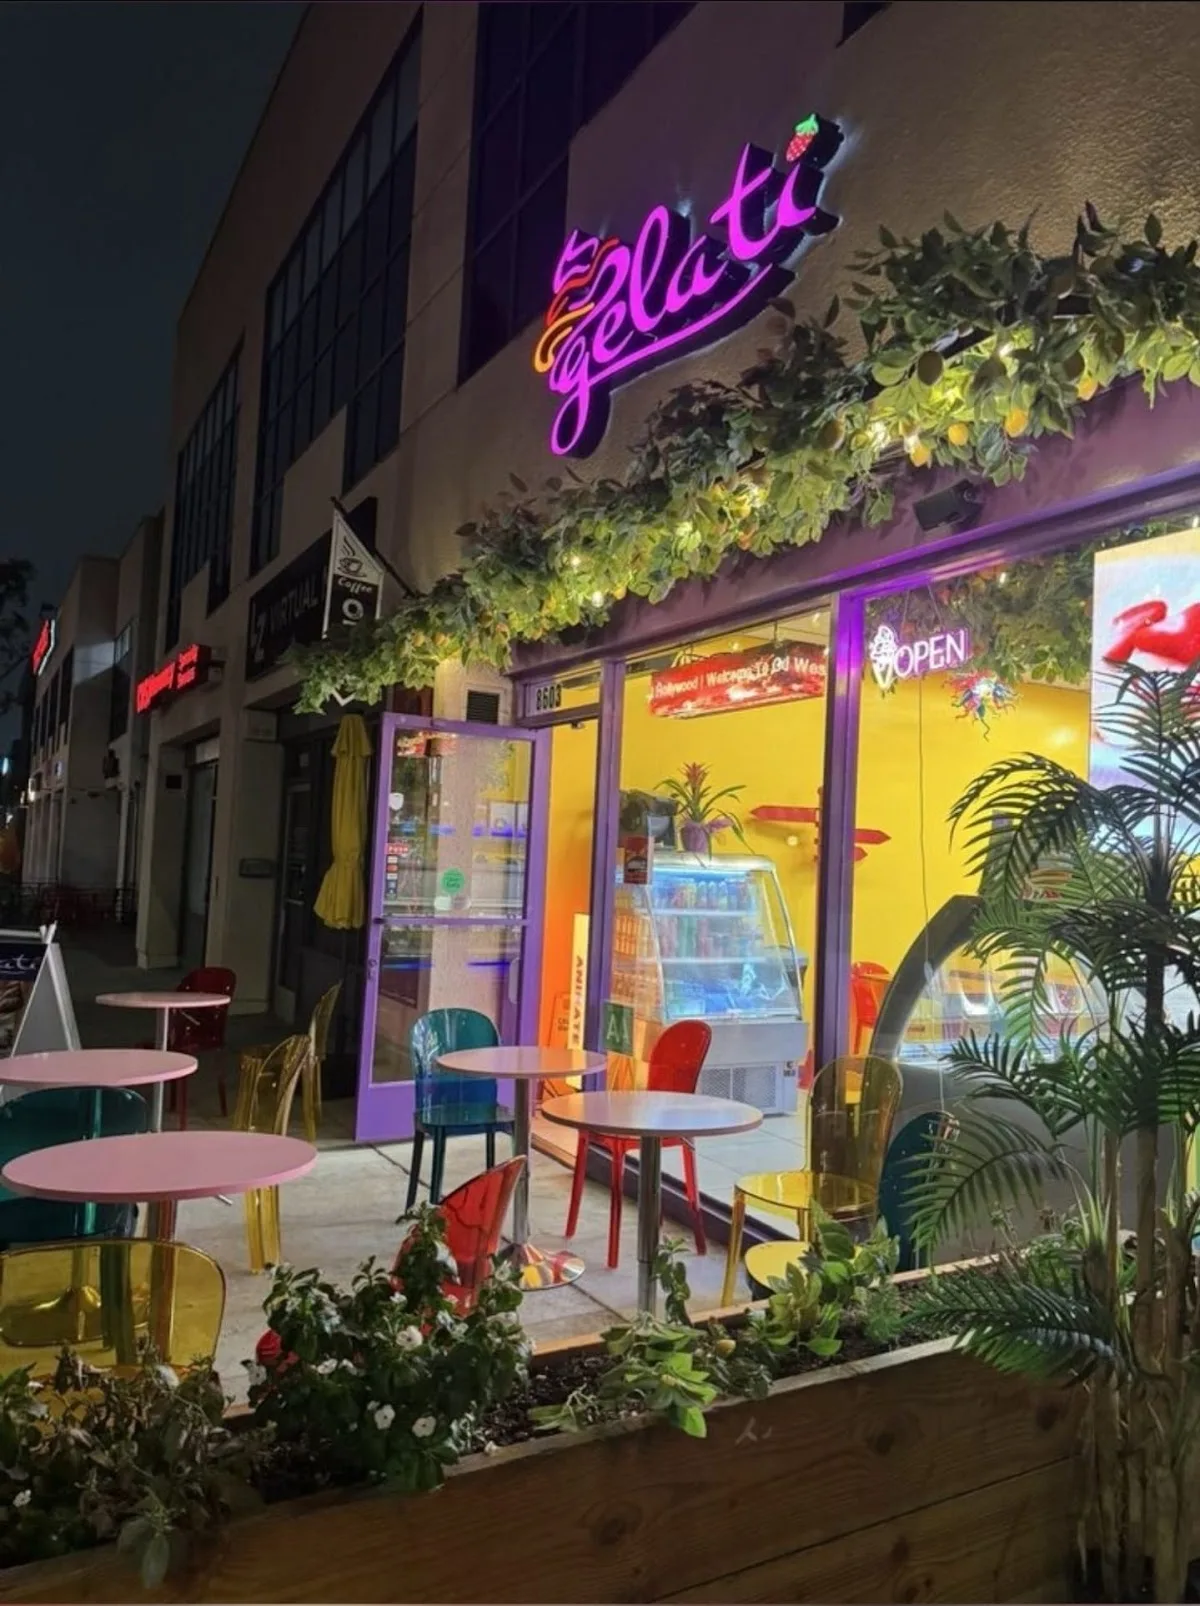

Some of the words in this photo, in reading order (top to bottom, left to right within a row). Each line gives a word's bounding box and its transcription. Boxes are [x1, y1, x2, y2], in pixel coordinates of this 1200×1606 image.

[549, 113, 819, 455] gelati
[338, 577, 373, 595] Coffee
[894, 628, 965, 678] OPEN
[536, 683, 562, 711] 8603
